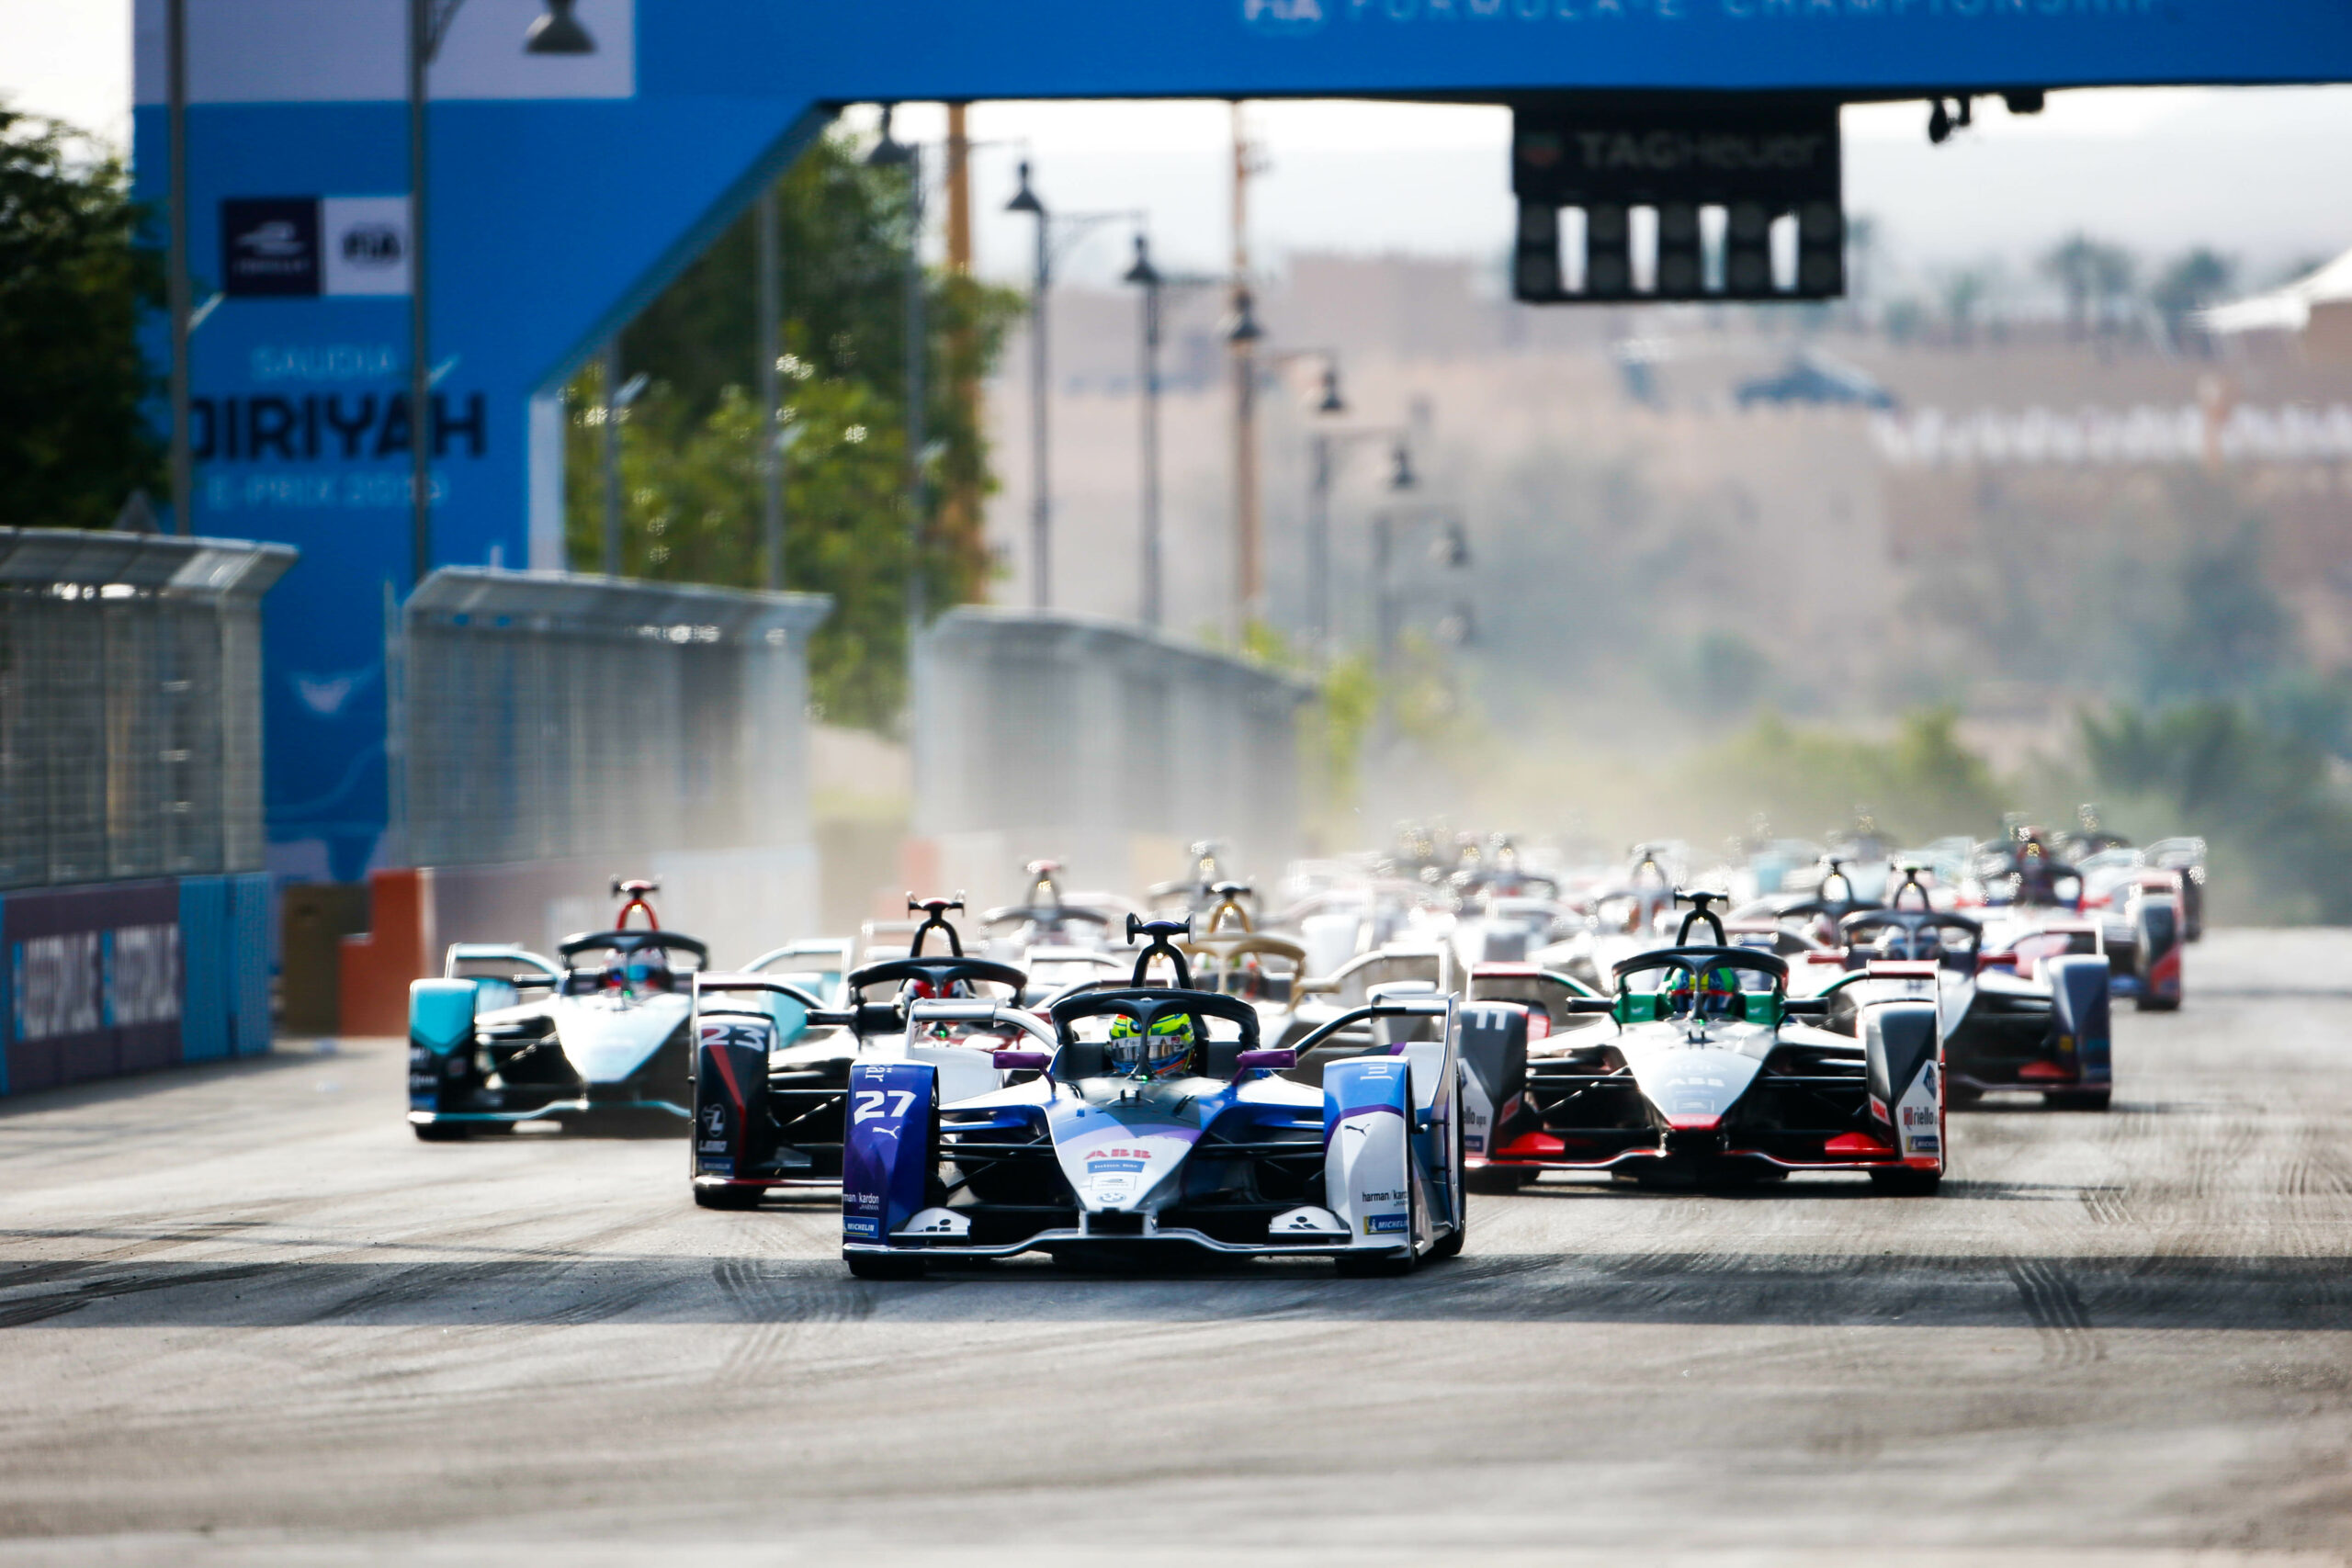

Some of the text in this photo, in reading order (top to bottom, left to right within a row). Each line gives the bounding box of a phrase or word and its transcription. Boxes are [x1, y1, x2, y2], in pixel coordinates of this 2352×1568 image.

[698, 1024, 766, 1053] 23
[853, 1089, 917, 1125] 27
[1083, 1148, 1152, 1159] ABB
[847, 1223, 875, 1232] MICHELIN
